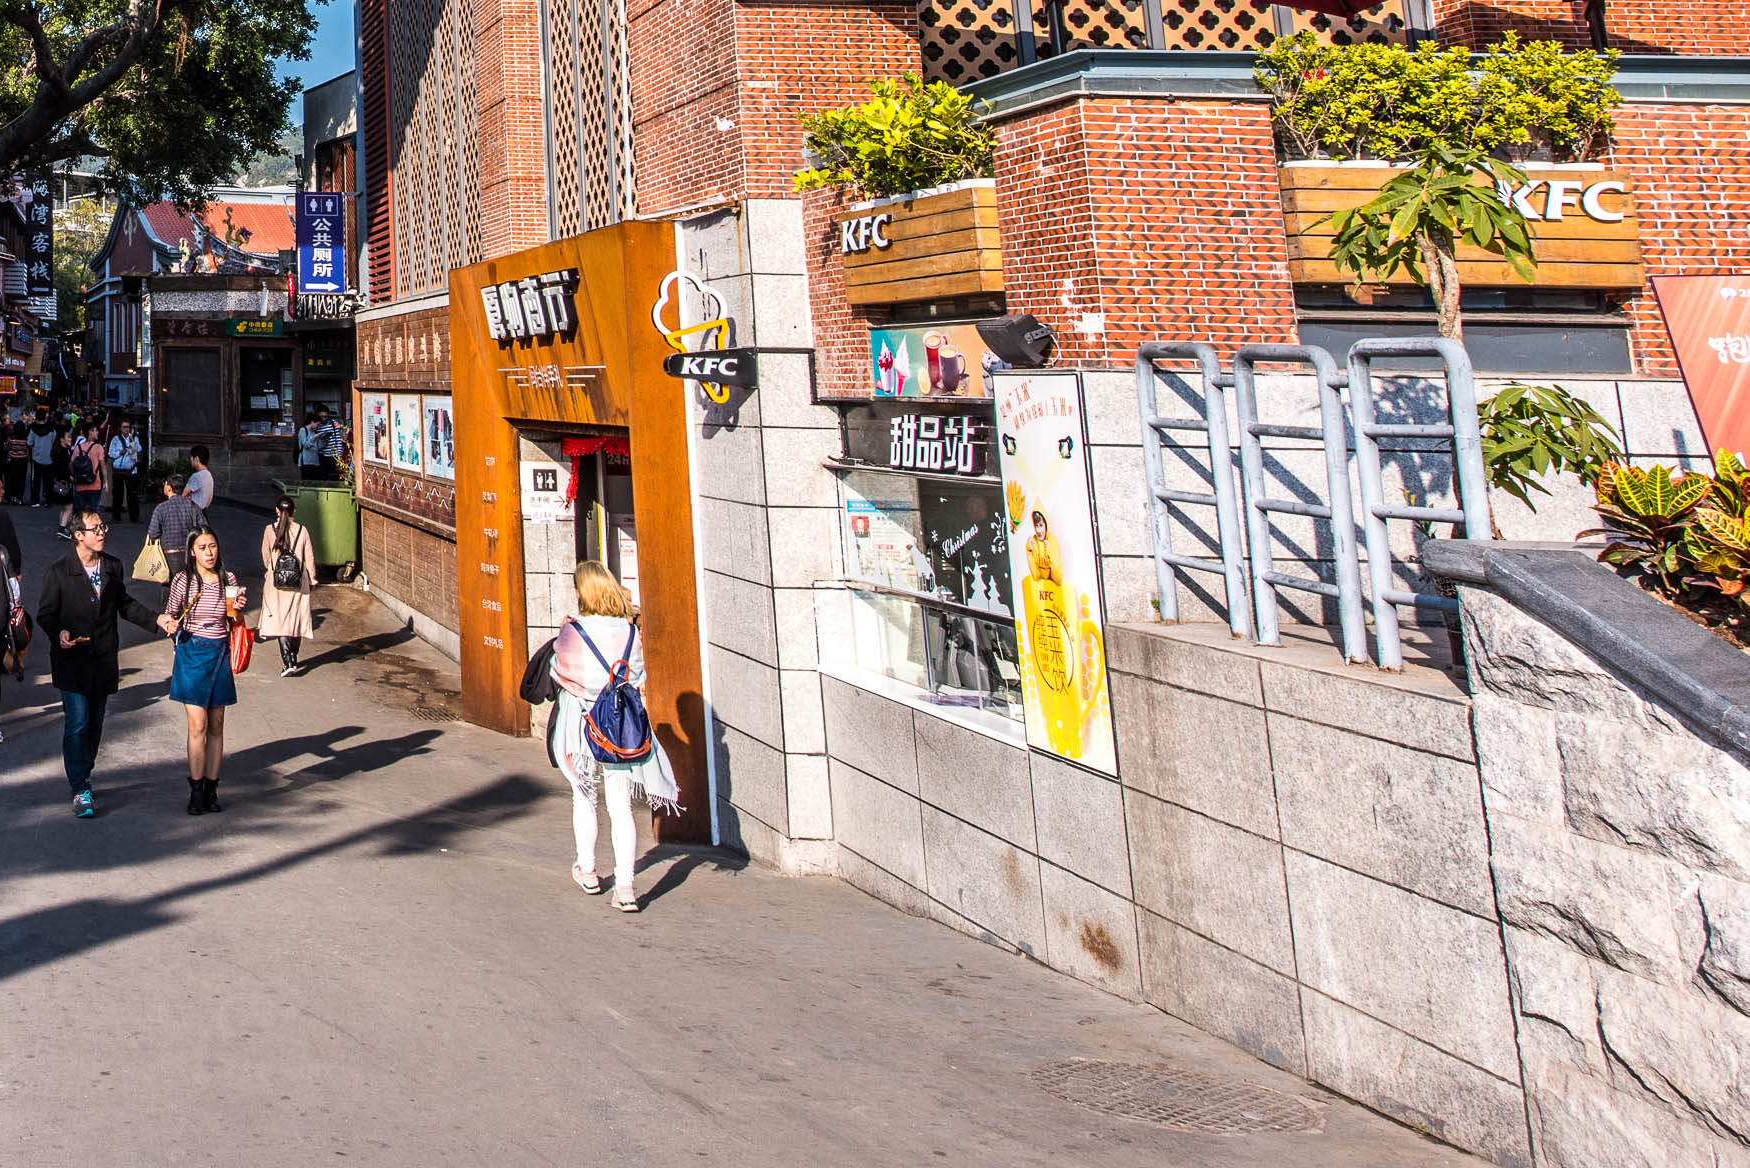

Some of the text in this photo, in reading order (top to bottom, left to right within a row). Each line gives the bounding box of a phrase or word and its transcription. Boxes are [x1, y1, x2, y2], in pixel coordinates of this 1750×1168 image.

[1497, 179, 1625, 223] KFC
[30, 179, 50, 292] 海湾客栈
[312, 218, 333, 277] 公共厕所
[841, 213, 888, 252] KFC
[680, 356, 738, 376] KFC
[890, 414, 975, 473] 甜品站
[941, 524, 979, 558] Christmas
[1039, 590, 1055, 601] KFC
